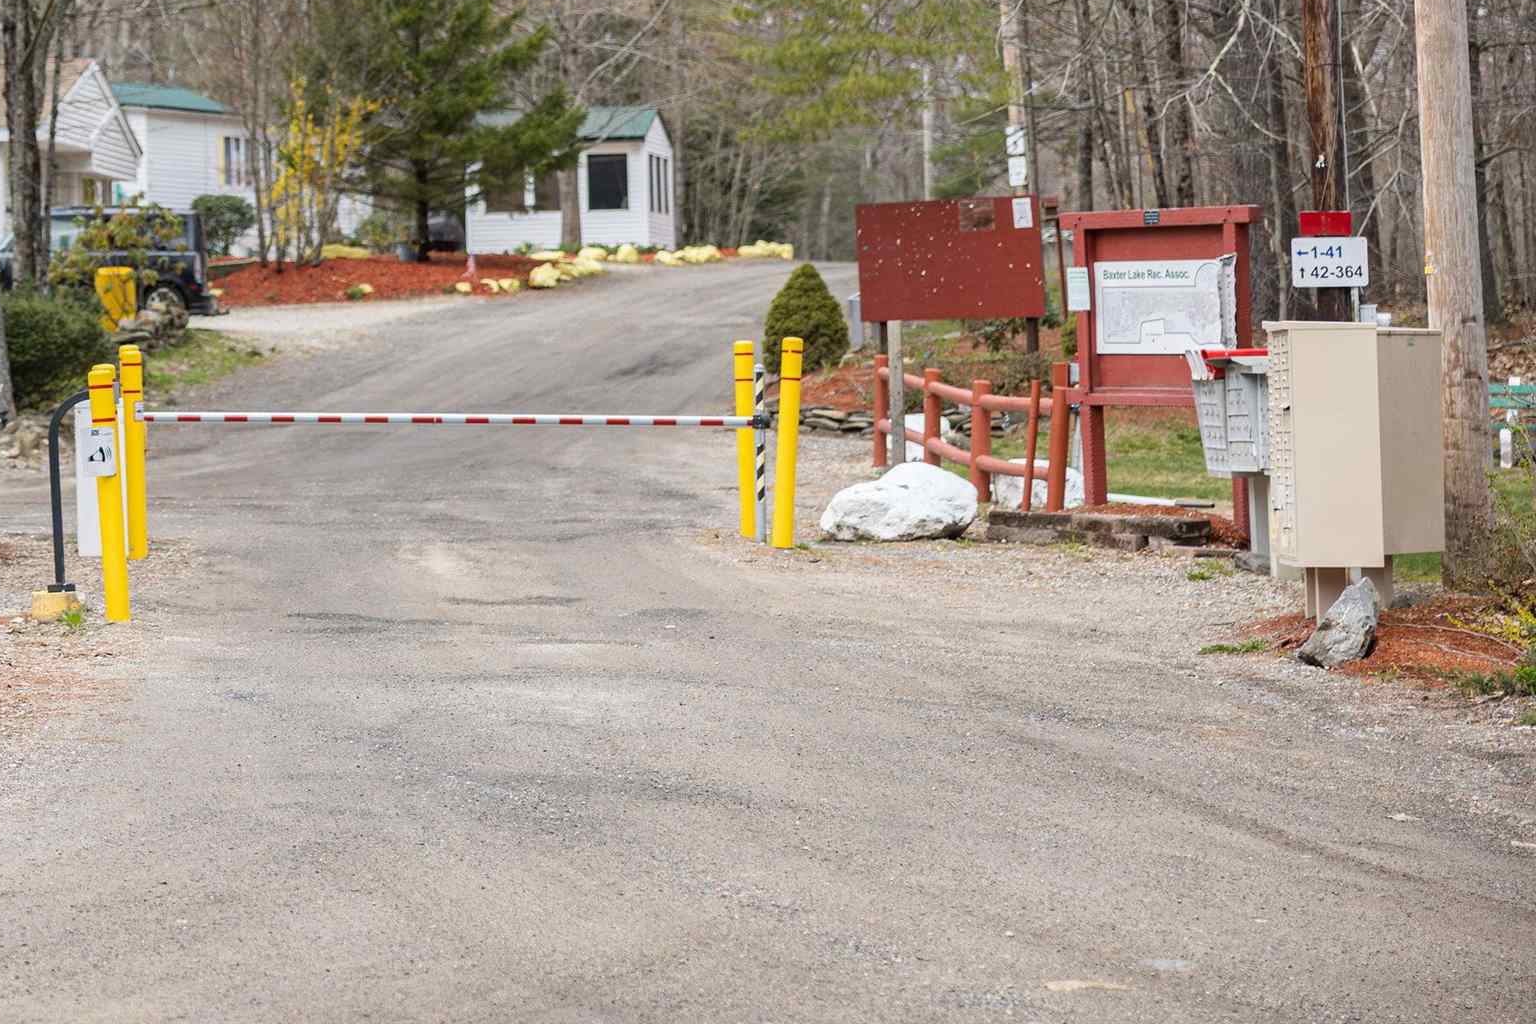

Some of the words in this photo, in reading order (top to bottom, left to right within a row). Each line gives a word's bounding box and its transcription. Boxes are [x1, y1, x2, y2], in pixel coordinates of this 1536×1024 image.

[1311, 246, 1342, 258] 1-41
[1103, 269, 1126, 280] Baxter
[1128, 269, 1145, 280] Lake
[1311, 265, 1363, 279] 42-364
